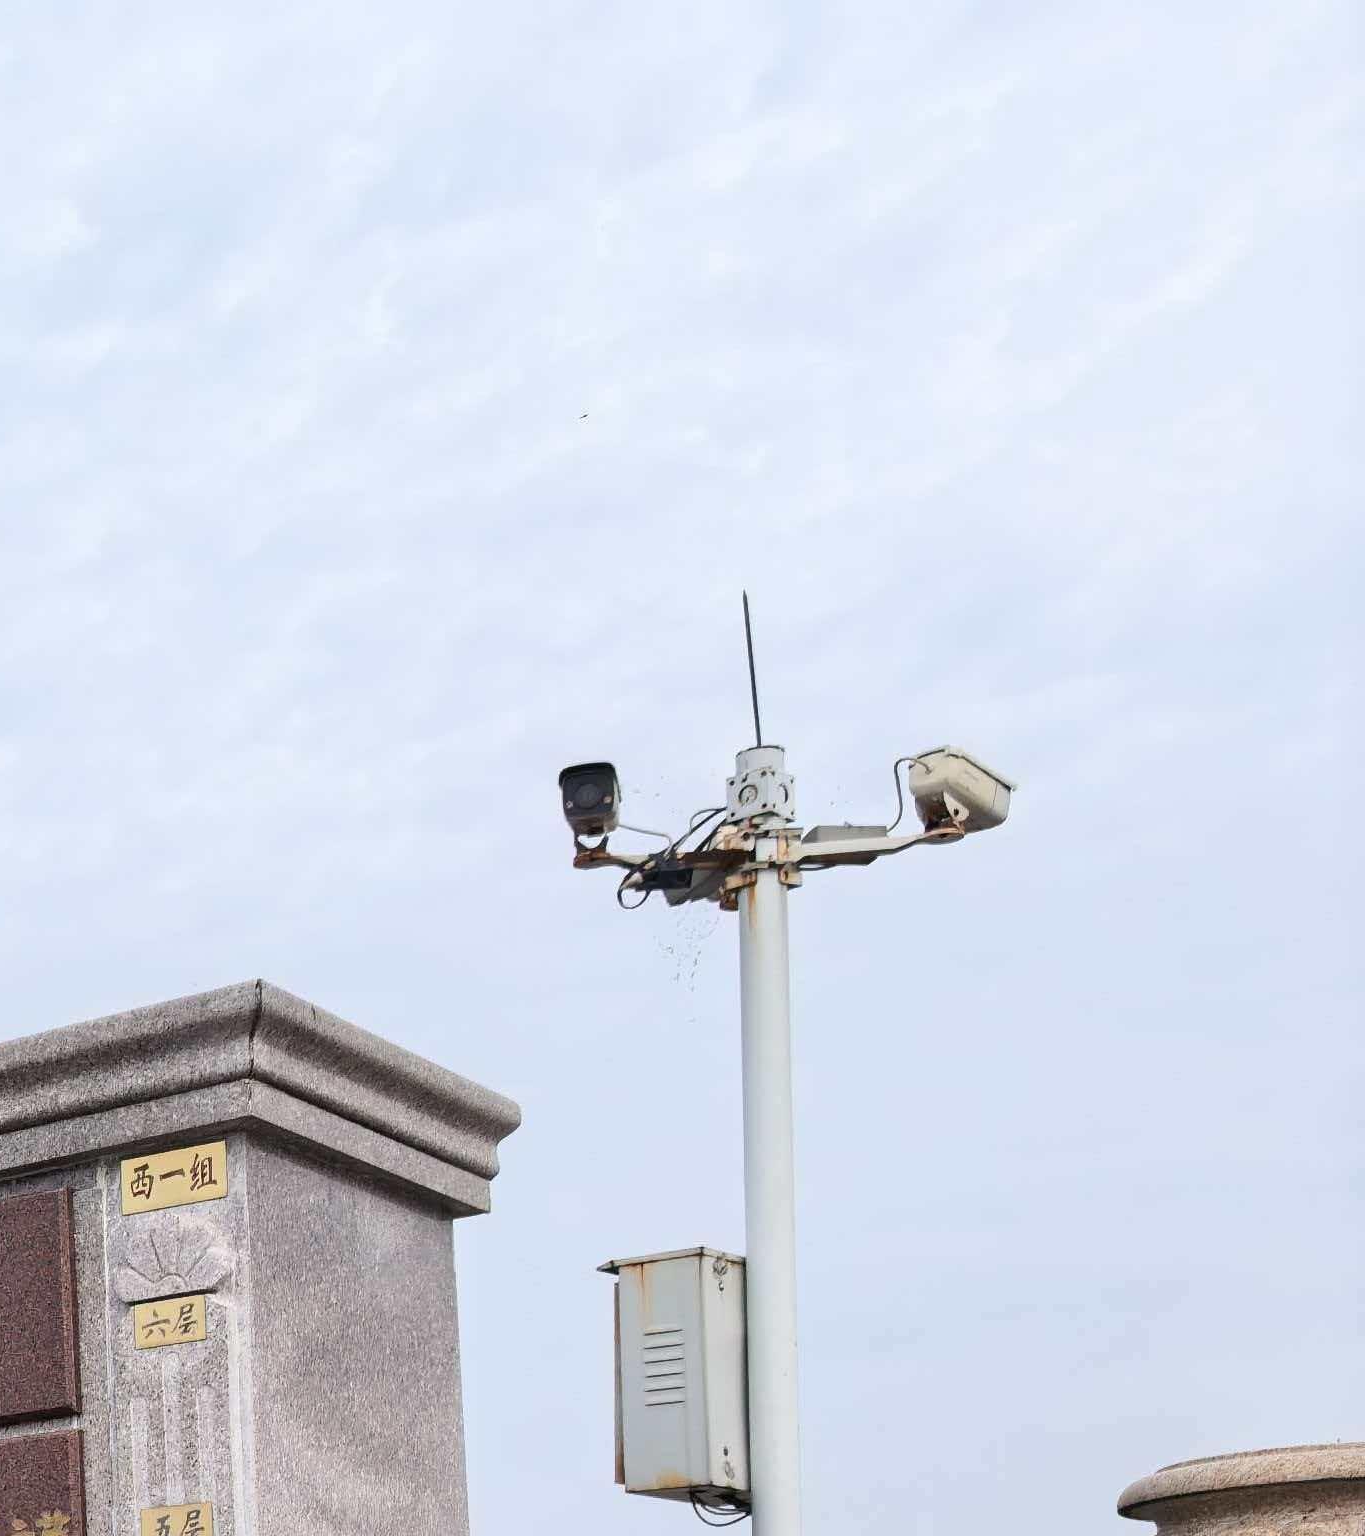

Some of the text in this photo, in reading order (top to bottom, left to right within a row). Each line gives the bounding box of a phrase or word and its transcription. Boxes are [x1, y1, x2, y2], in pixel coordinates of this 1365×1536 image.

[130, 1153, 218, 1199] 西一组
[141, 1303, 197, 1339] 六层
